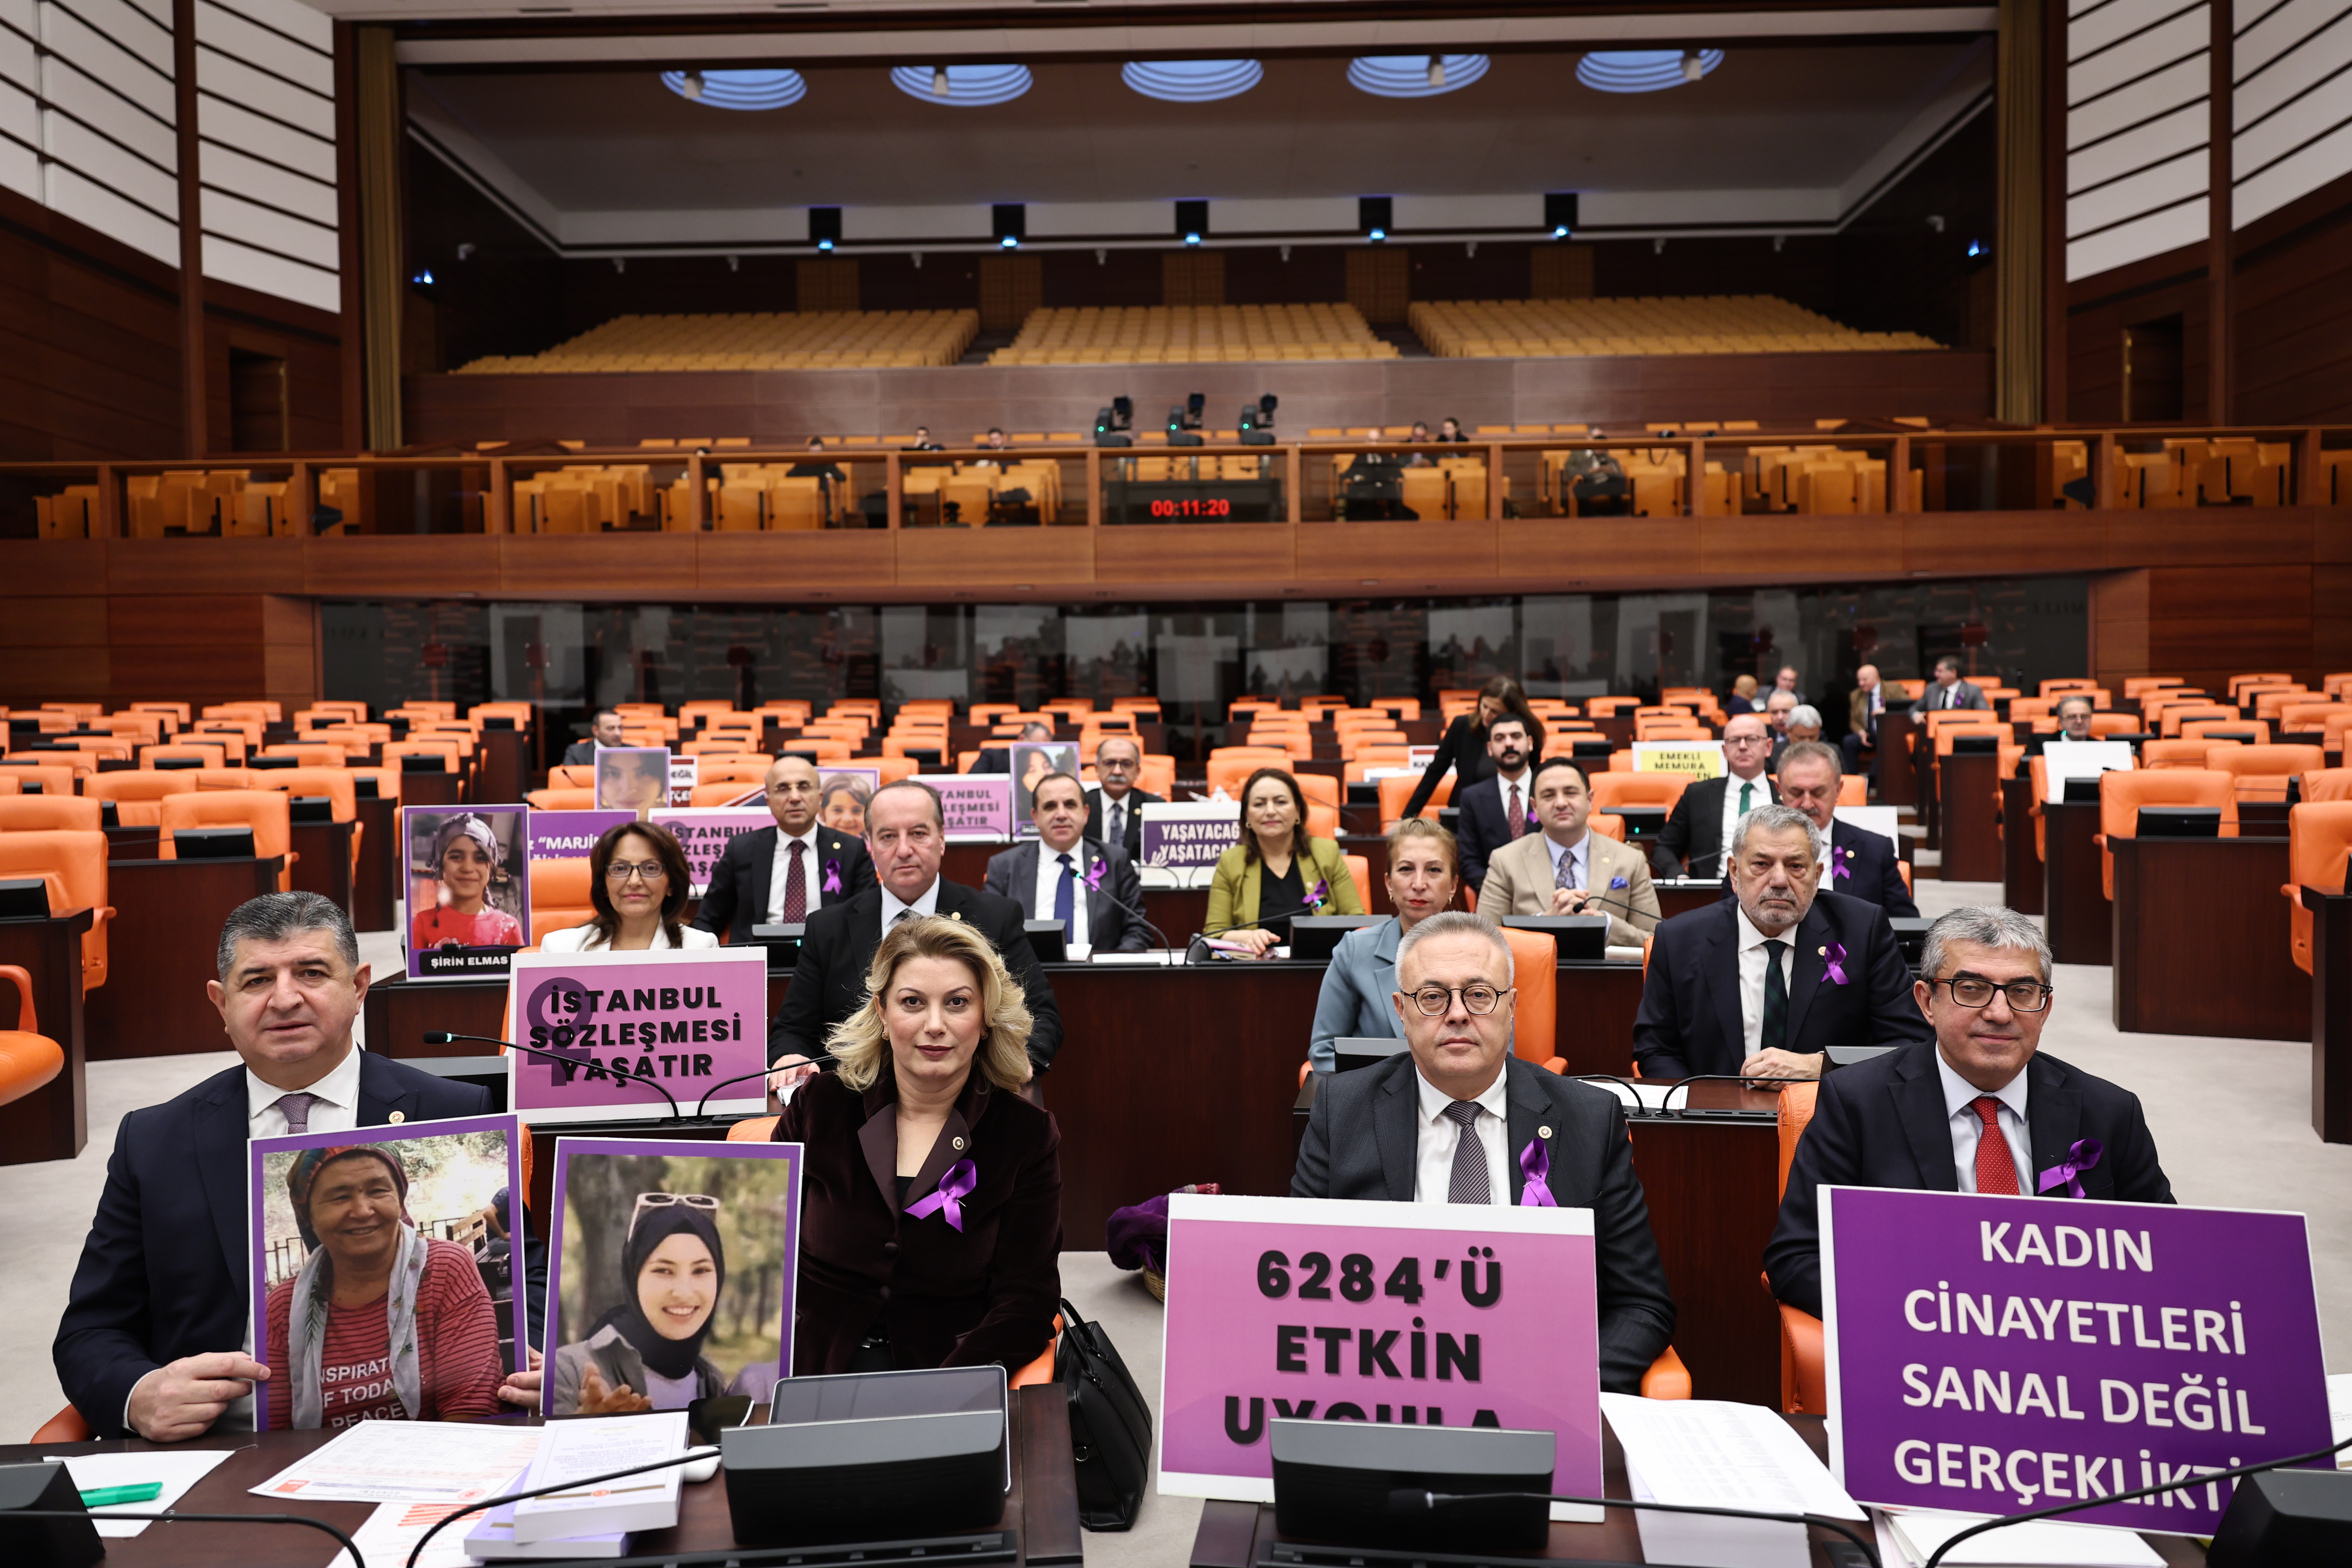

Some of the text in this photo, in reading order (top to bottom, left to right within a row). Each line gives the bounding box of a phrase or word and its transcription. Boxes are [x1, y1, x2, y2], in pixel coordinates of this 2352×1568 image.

[1151, 499, 1229, 516] 00:11:20
[671, 769, 693, 779] EĞİL
[940, 790, 991, 799] TANBUL
[944, 800, 999, 815] LEŞMESİ
[948, 817, 987, 828] ŞATIR
[1161, 821, 1240, 843] YAŞAYACAĞ
[431, 956, 508, 969] ŞİRİN ELMAS
[551, 985, 722, 1013] İSTANBUL
[529, 1013, 741, 1052] SÖZLEŞMESİ
[559, 1054, 713, 1087] YAŞATIR
[1980, 1221, 2153, 1272] KADIN
[1904, 1281, 2246, 1355] CİNAYETLERİ
[1276, 1317, 1480, 1381] ETKİN
[340, 1378, 394, 1404] TODA
[1902, 1363, 2266, 1436] SANAL DEĞİL
[332, 1403, 404, 1427] PEACE
